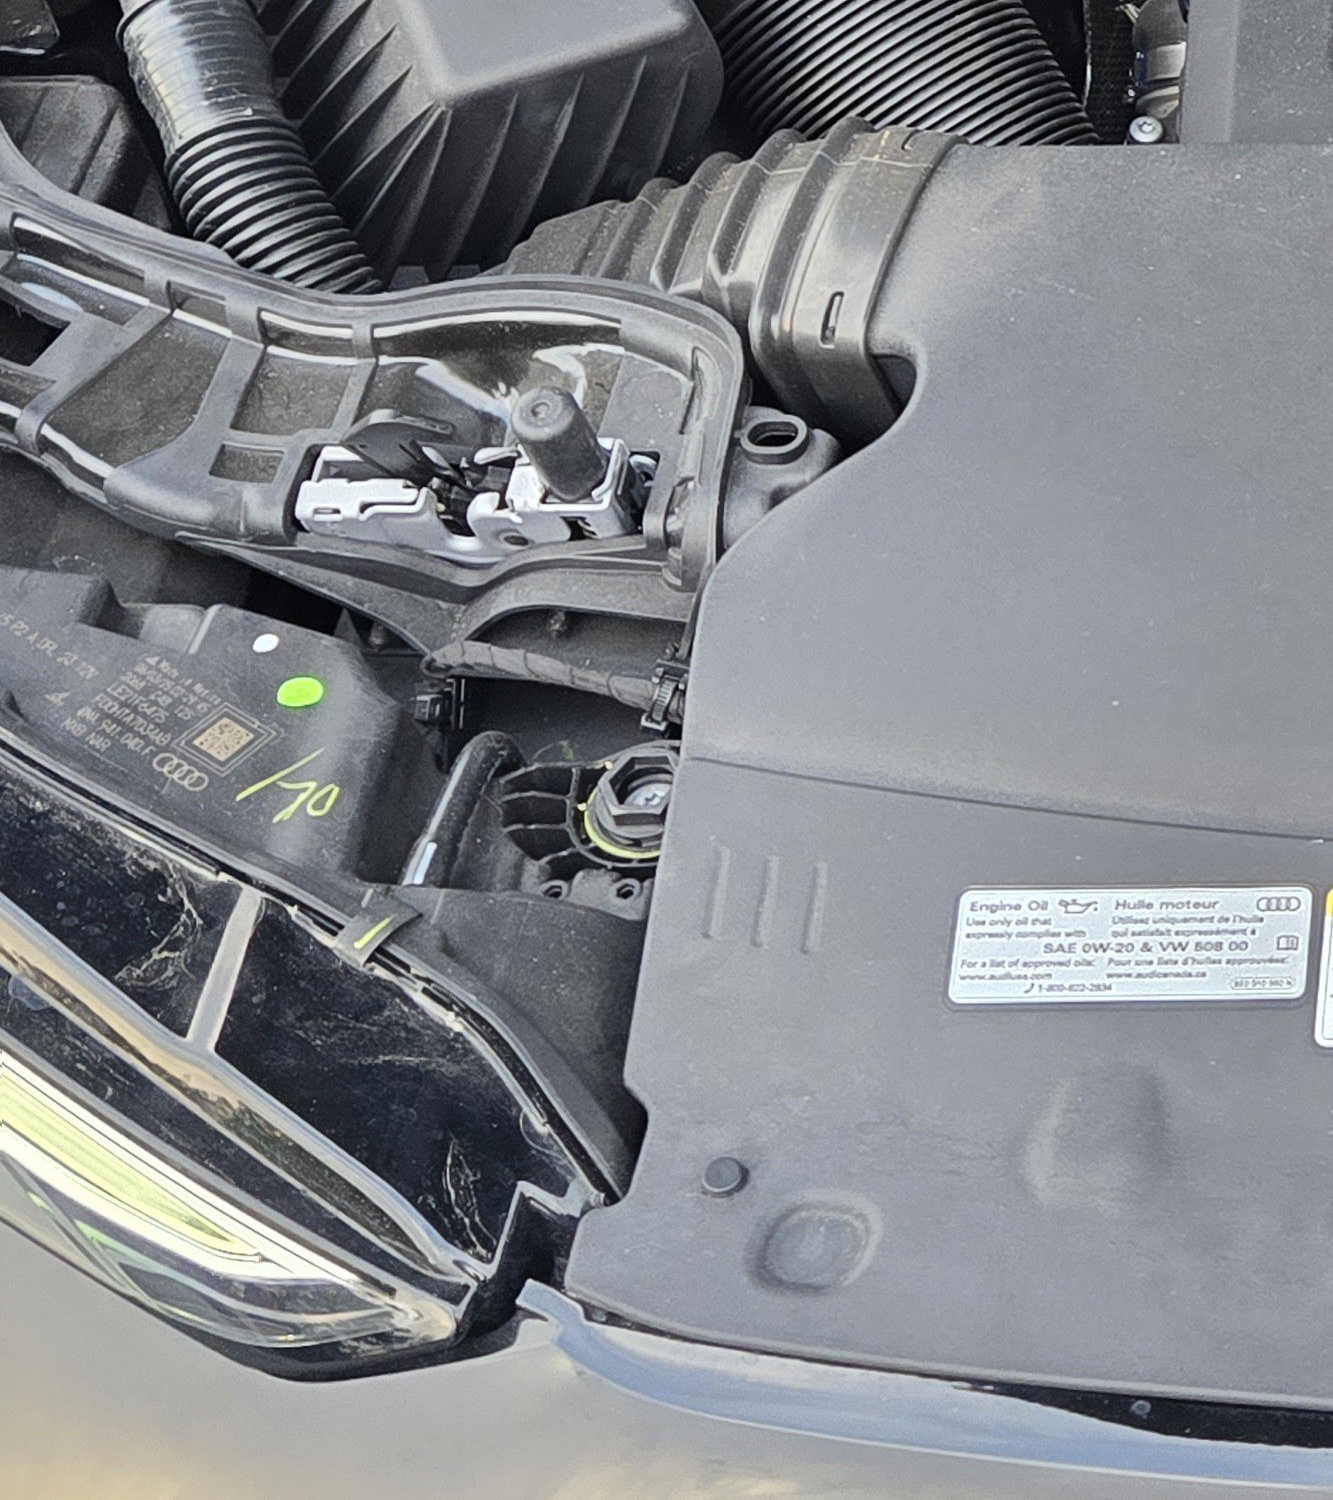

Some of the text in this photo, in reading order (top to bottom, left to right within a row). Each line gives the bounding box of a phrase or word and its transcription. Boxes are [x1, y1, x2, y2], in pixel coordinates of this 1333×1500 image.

[969, 900, 1048, 913] Engine Oil
[1115, 899, 1219, 909] Huile moteur
[988, 918, 1012, 928] only
[1015, 917, 1028, 925] oil
[1031, 917, 1051, 925] that
[1152, 915, 1214, 925] uniquement
[1111, 928, 1127, 938] qui
[1043, 940, 1248, 953] SAE 0W-20 & VW 508 00
[960, 959, 978, 968] For
[989, 959, 1005, 967] list
[1008, 959, 1019, 967] of
[1022, 959, 1071, 969] approved
[1107, 957, 1131, 966] Pour
